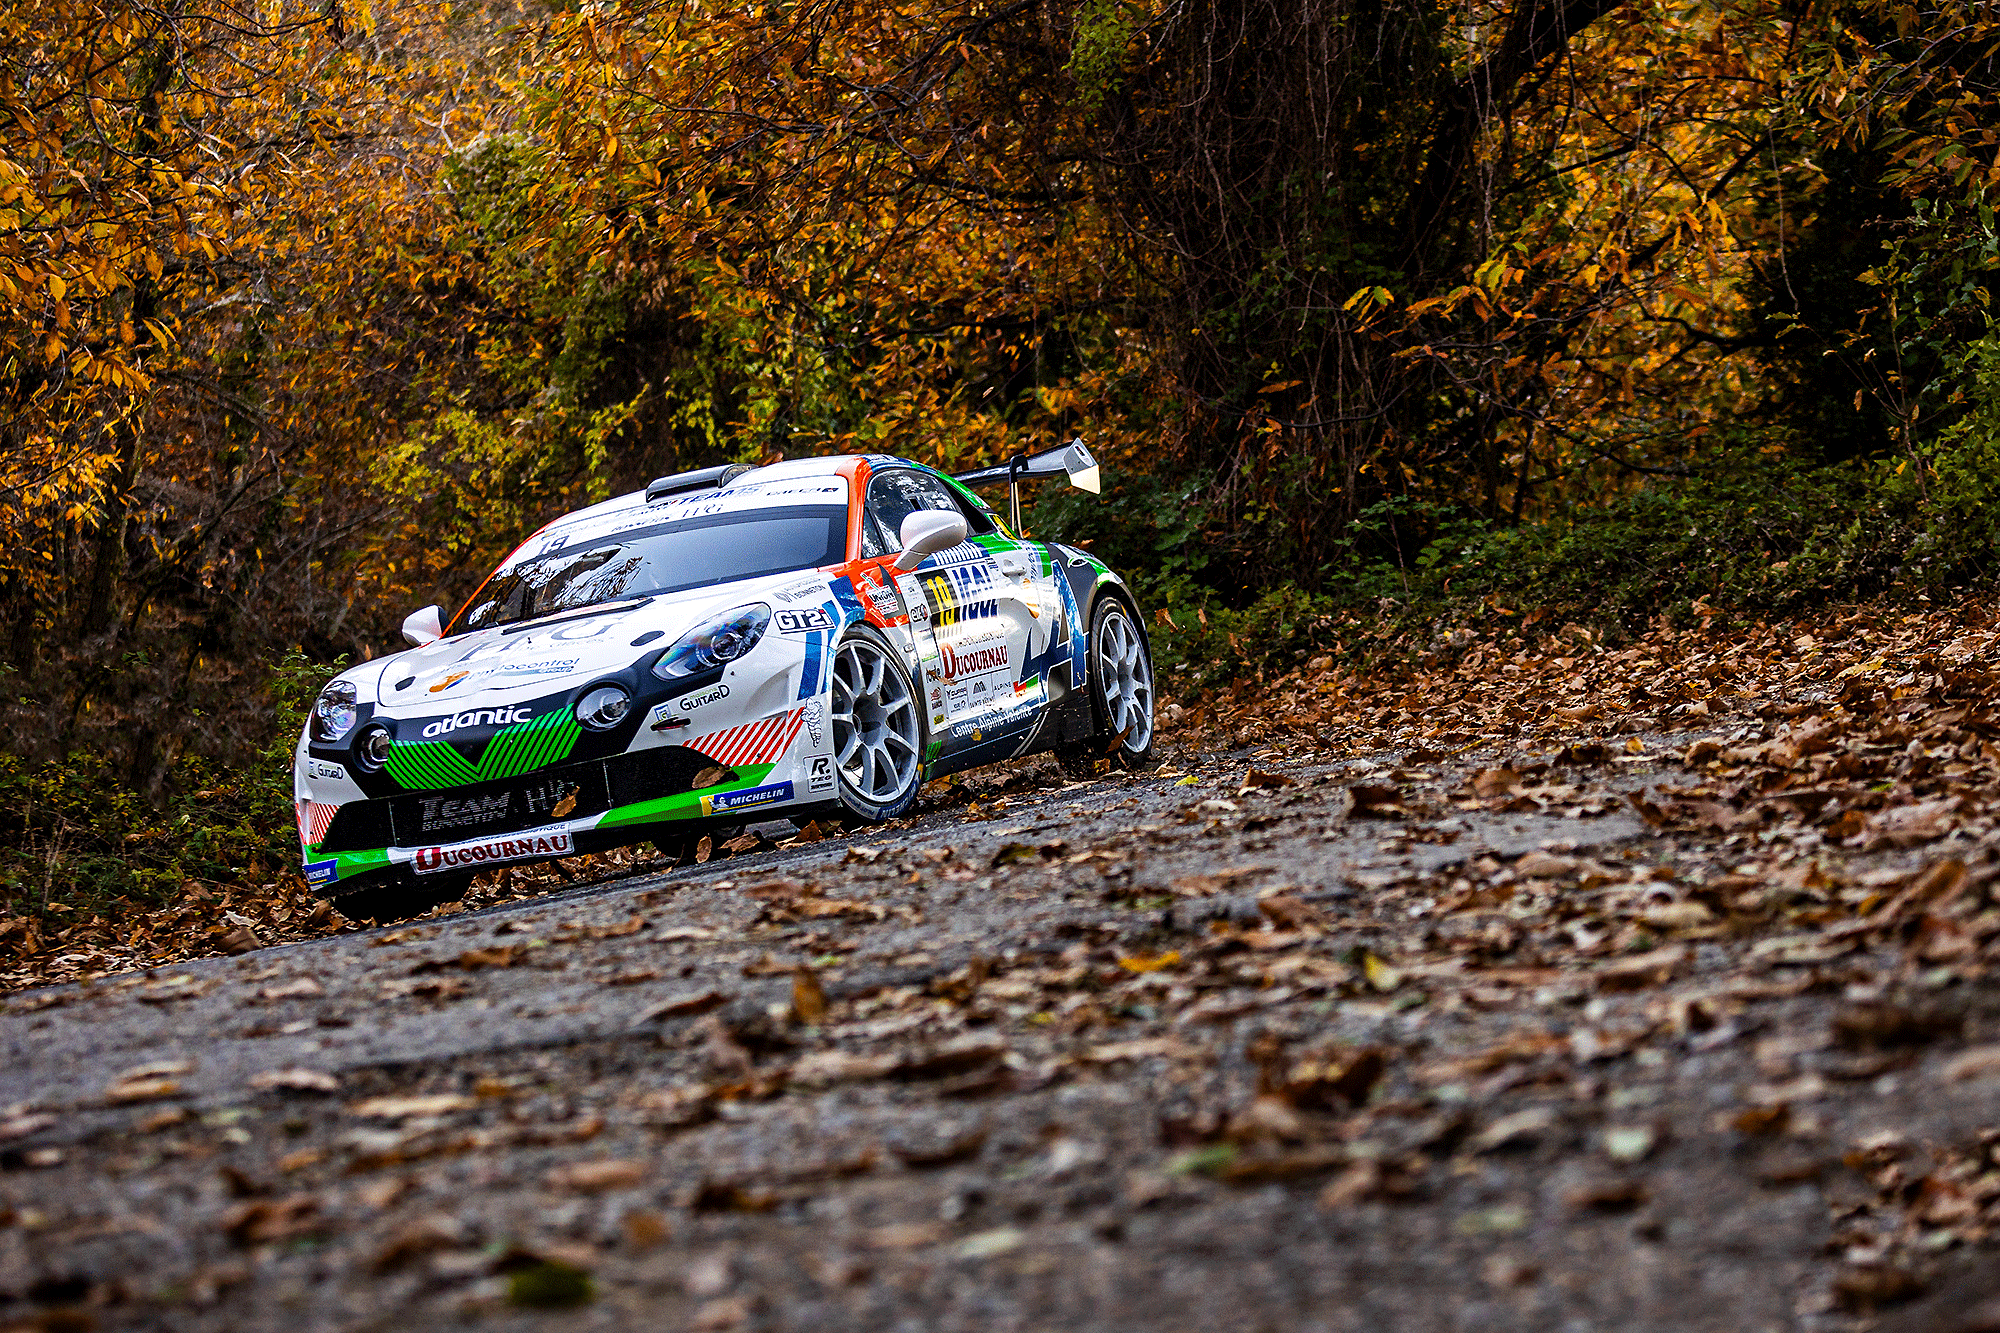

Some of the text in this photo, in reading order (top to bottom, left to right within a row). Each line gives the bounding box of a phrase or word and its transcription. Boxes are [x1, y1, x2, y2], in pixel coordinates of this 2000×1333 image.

[939, 642, 1008, 680] DUCOURNAU
[422, 705, 532, 738] atlantic
[730, 788, 784, 805] MICHELIN
[415, 835, 568, 871] DUCOURNAU
